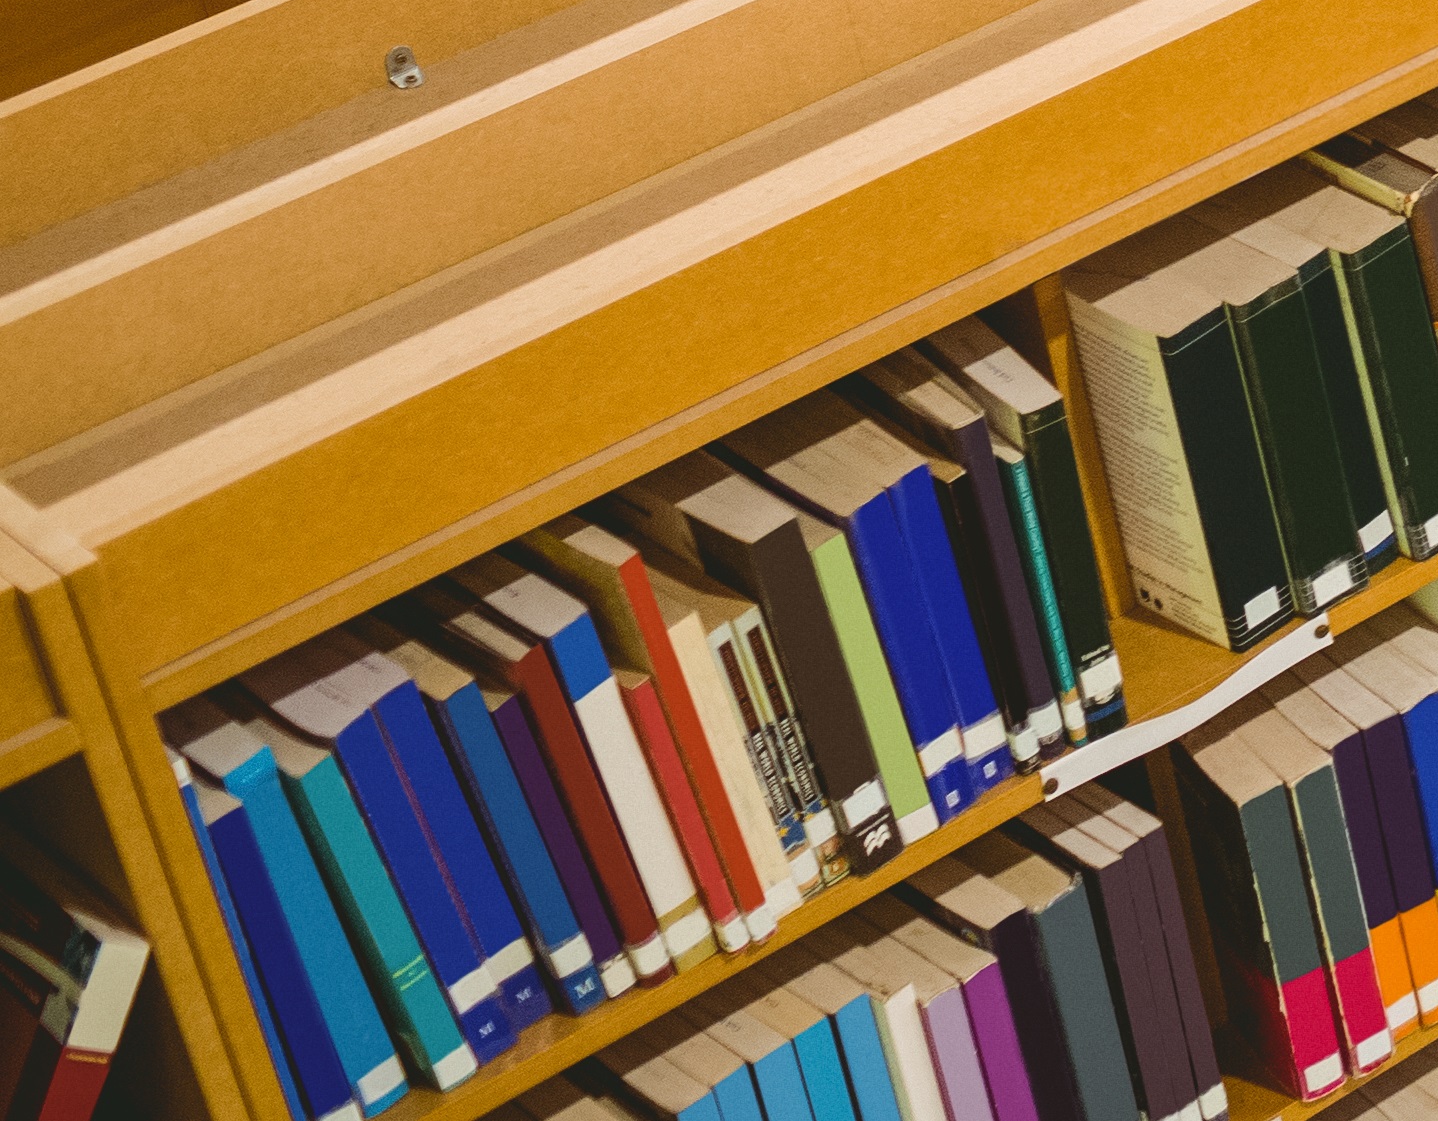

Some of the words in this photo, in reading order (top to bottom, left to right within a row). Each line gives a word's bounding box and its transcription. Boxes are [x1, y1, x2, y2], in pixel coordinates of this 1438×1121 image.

[750, 732, 769, 749] REAL
[785, 739, 805, 762] WORLD
[755, 749, 777, 776] WORLD
[793, 762, 815, 801] ECONOMICS
[766, 777, 789, 814] ECONOMICS
